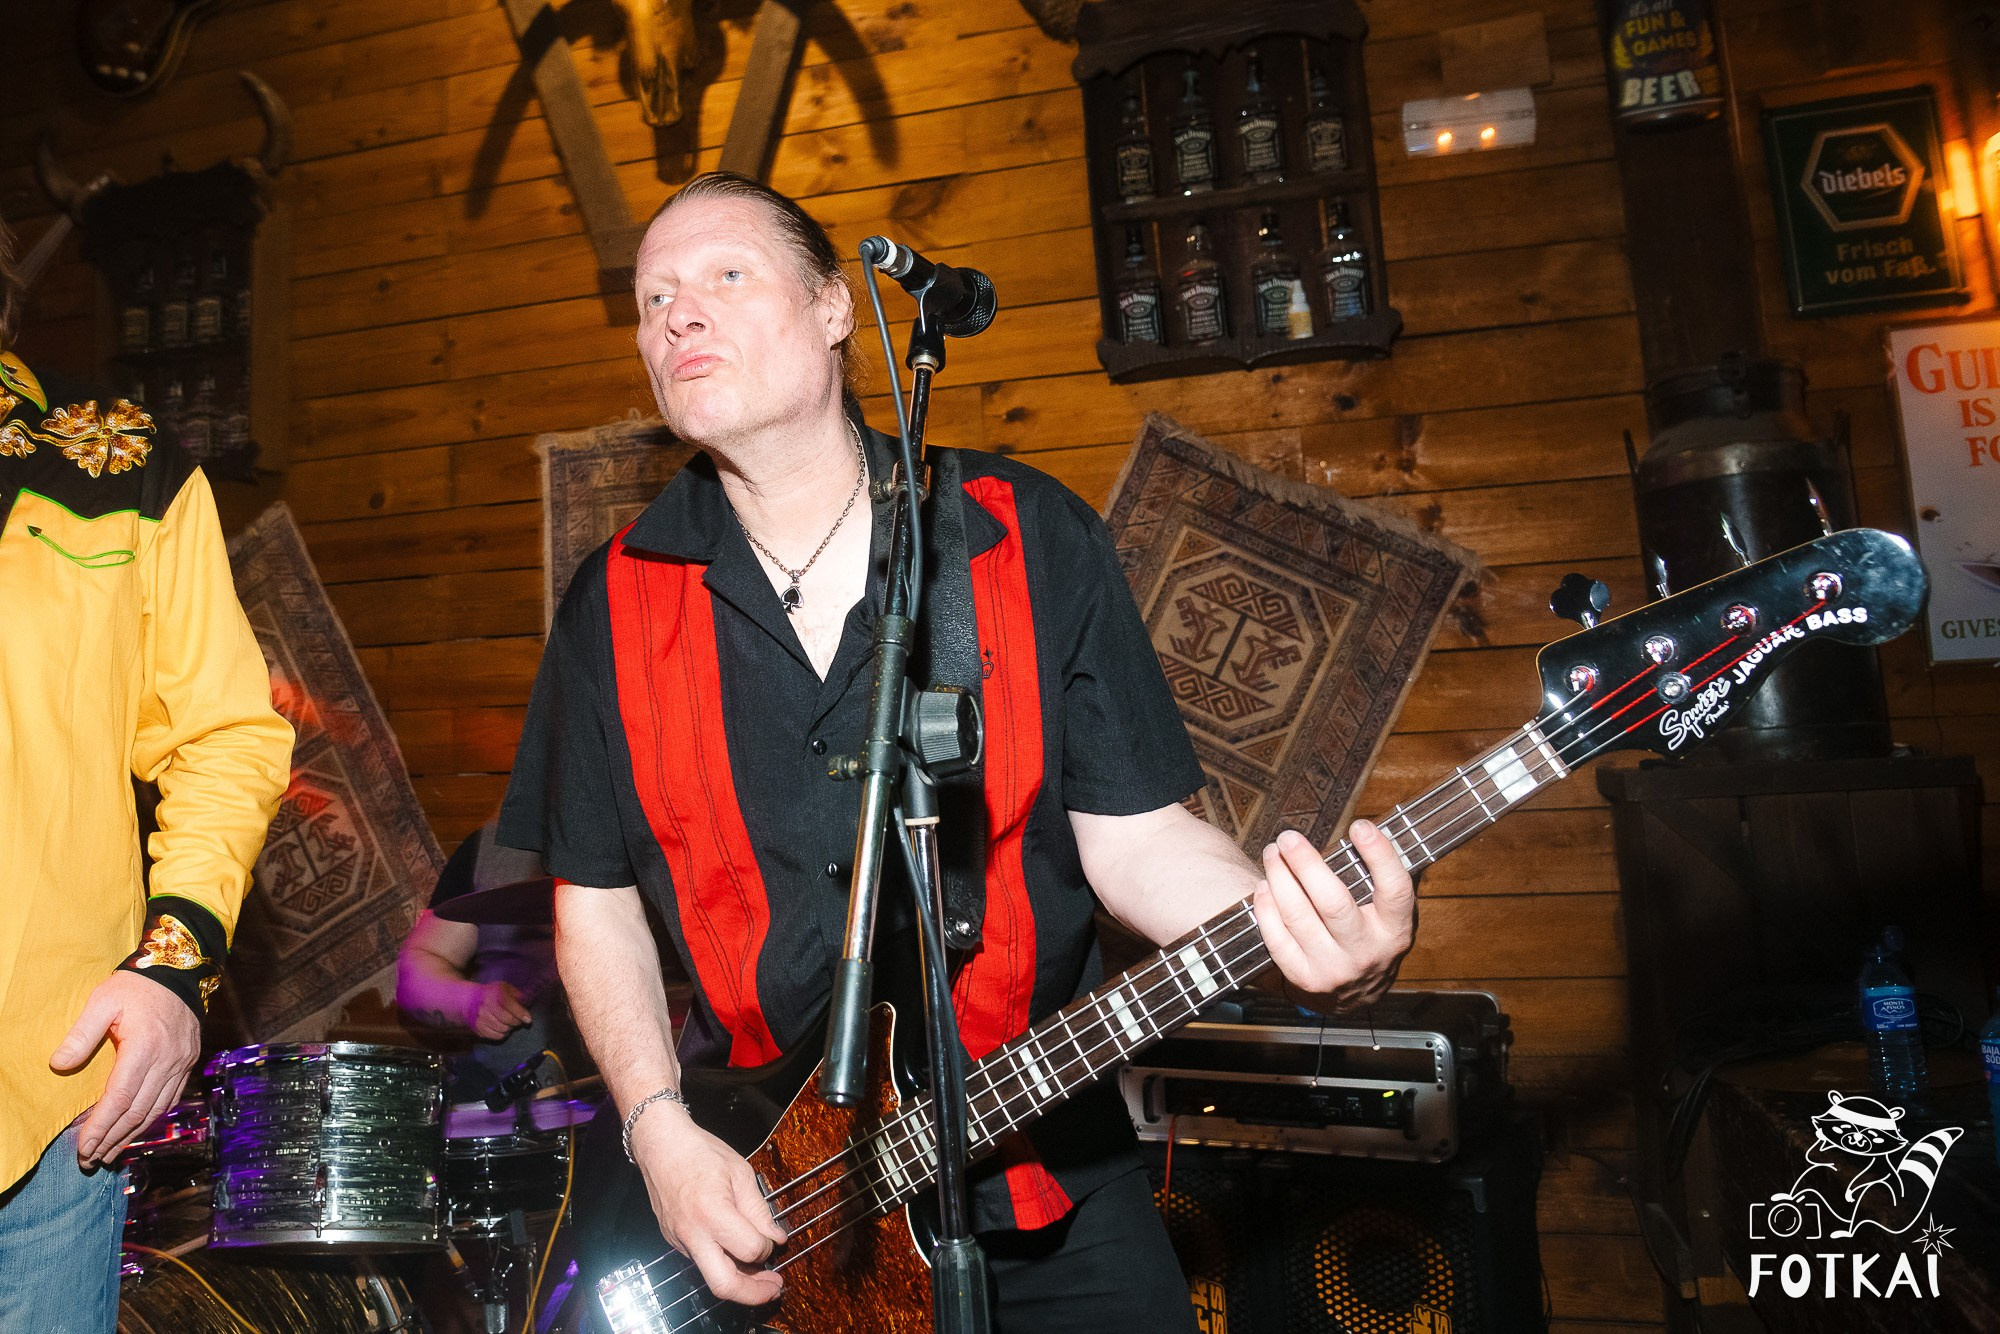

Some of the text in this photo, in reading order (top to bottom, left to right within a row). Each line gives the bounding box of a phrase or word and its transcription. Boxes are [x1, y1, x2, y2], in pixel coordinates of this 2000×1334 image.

[1625, 9, 1687, 38] FUN &
[1632, 31, 1697, 57] GAMES
[1620, 70, 1701, 107] BEER
[1819, 163, 1906, 194] Diebels
[1836, 237, 1914, 262] Frisch
[1825, 265, 1877, 285] vom
[1958, 398, 1996, 428] IS
[1941, 618, 2000, 639] GIVE
[1732, 607, 1868, 685] JAGUAR BASS
[1659, 677, 1731, 751] Squier
